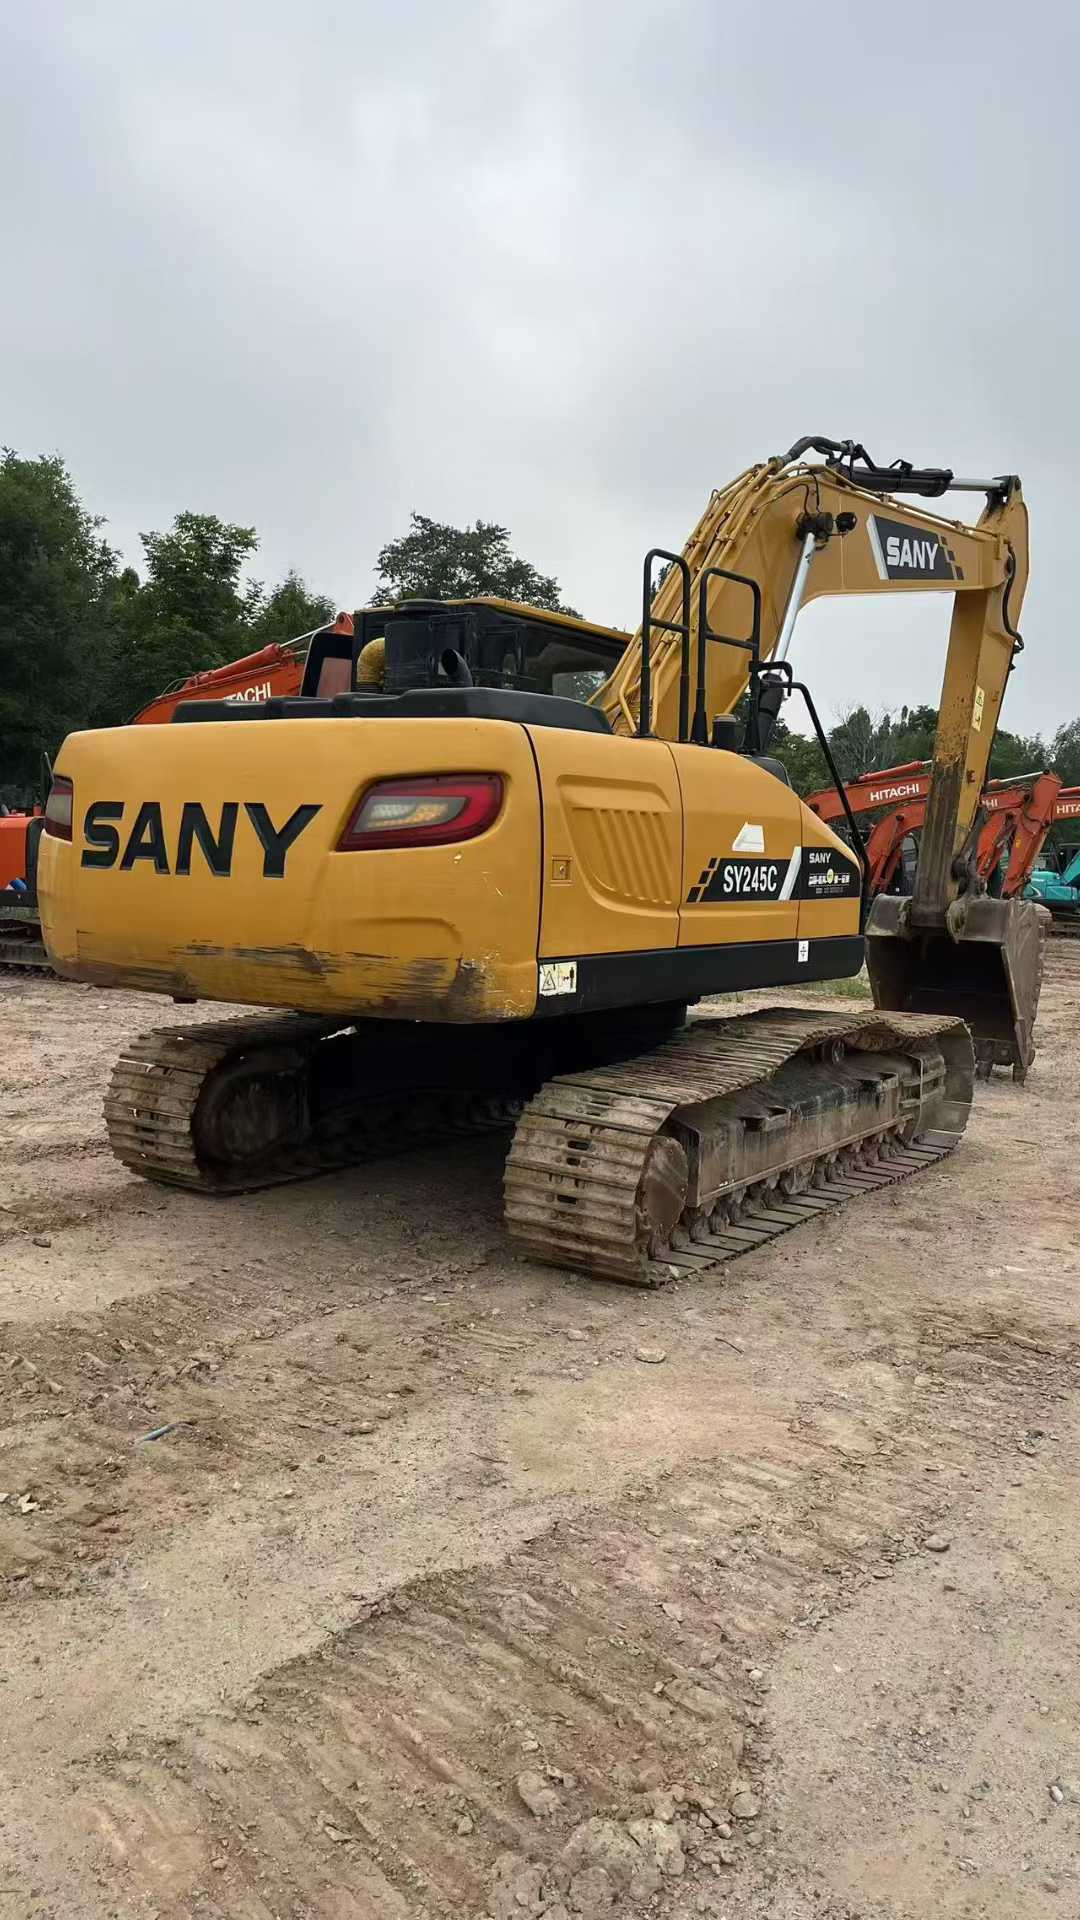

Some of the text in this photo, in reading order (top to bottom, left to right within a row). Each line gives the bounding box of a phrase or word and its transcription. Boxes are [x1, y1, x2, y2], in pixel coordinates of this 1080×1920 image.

[886, 536, 939, 570] SANY
[224, 681, 272, 702] ACHI
[870, 783, 920, 802] HITACHI
[80, 800, 324, 879] SANY
[809, 852, 831, 864] SANY
[723, 865, 778, 893] SY245C
